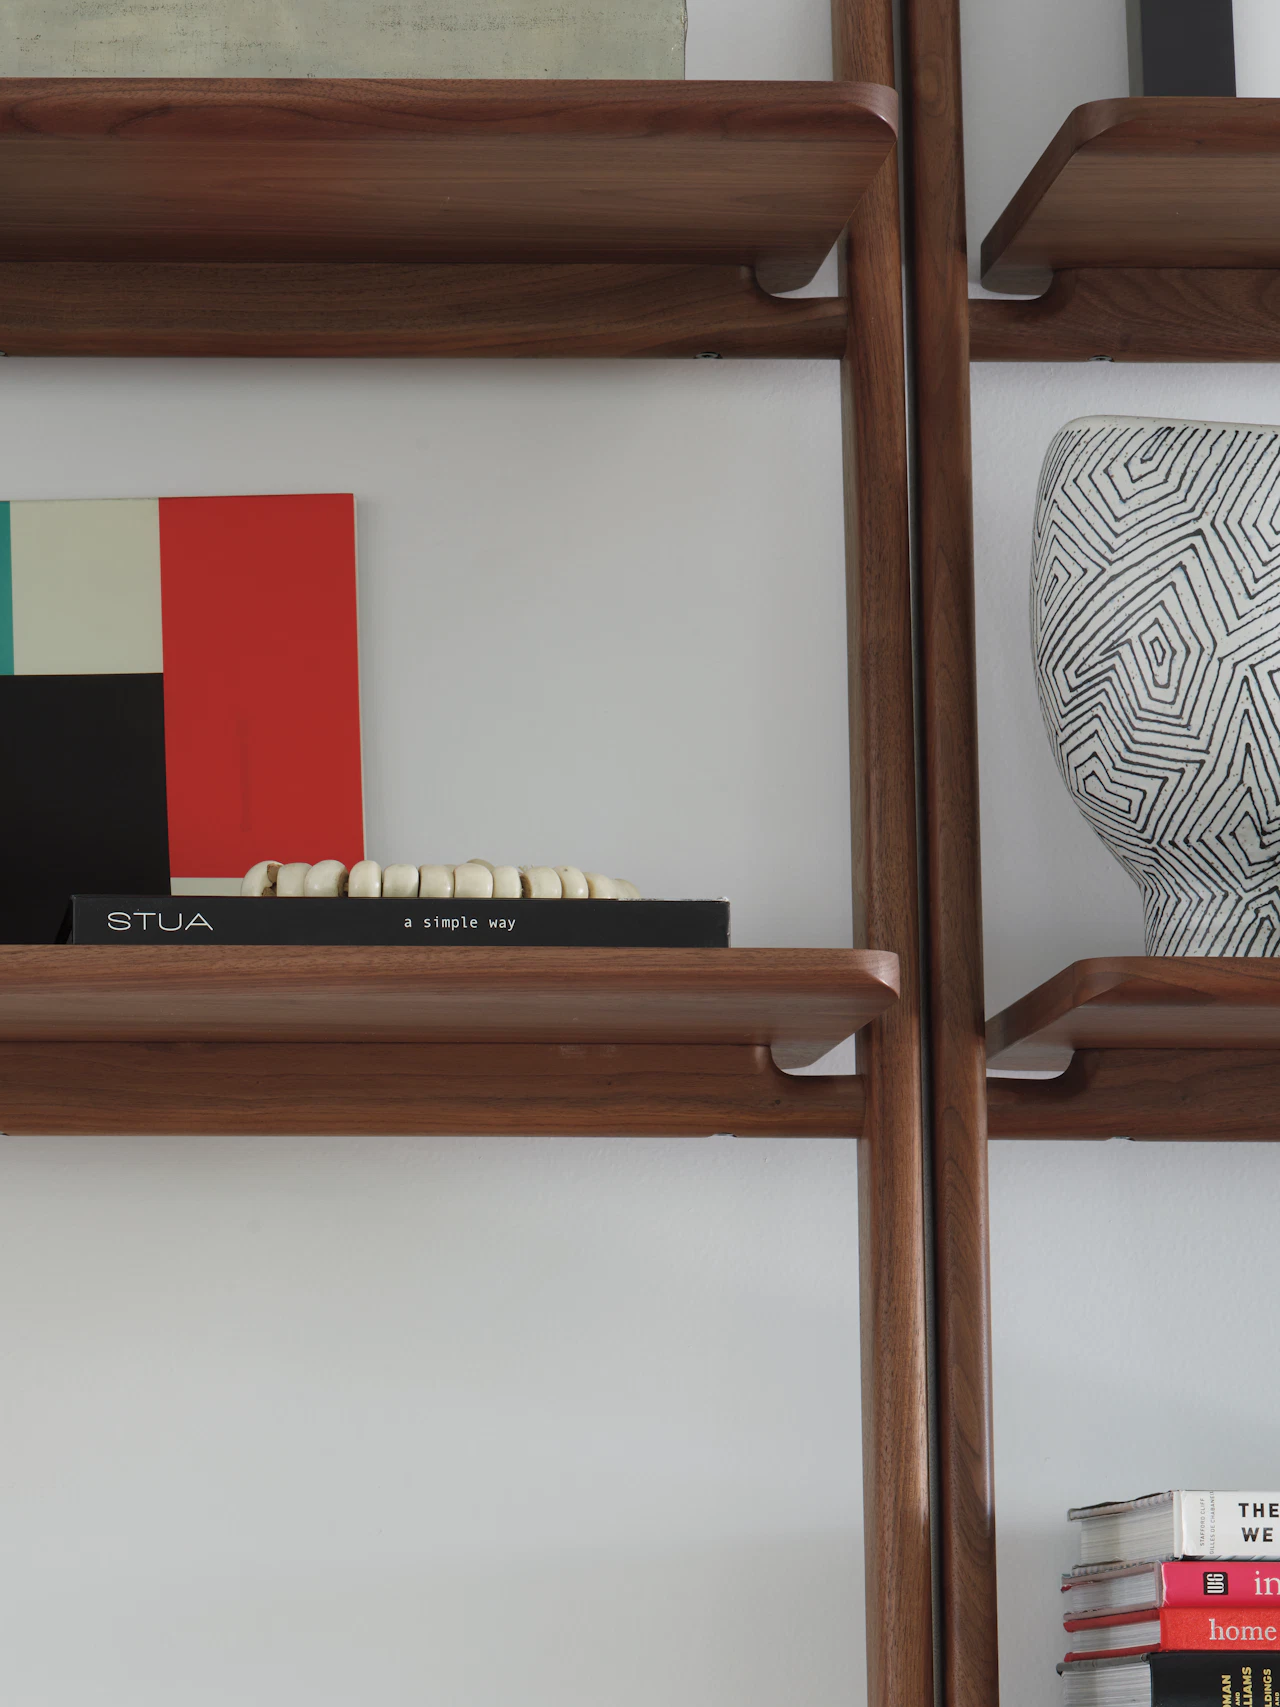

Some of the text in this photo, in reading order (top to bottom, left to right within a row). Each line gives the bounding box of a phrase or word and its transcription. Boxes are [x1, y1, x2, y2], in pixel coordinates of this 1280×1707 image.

[107, 911, 214, 932] STUA
[404, 915, 516, 930] a simple way
[1238, 1502, 1280, 1518] THE
[1210, 1525, 1216, 1533] DE
[1241, 1527, 1273, 1542] WE
[1208, 1617, 1277, 1641] home
